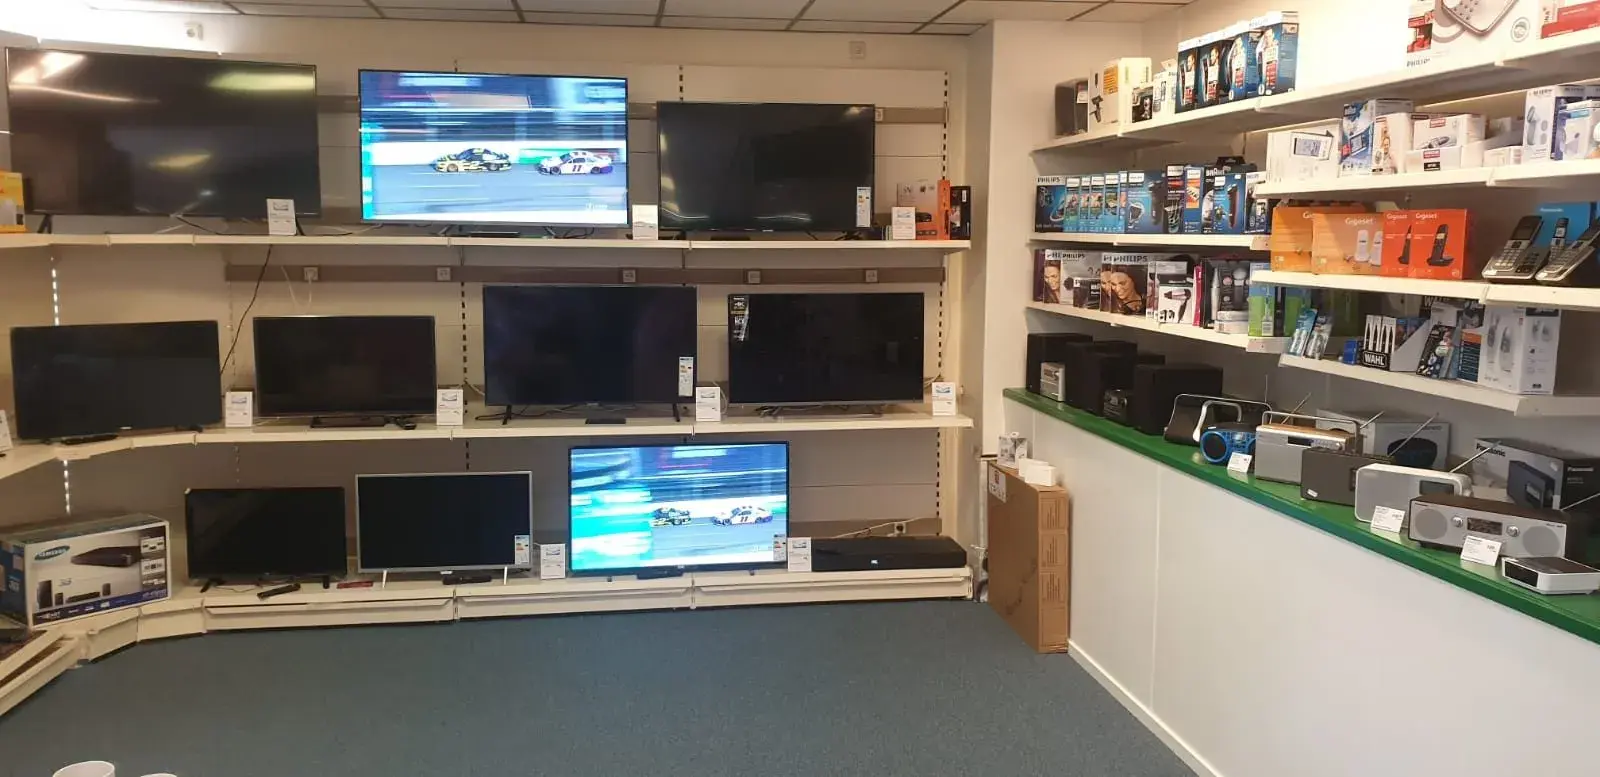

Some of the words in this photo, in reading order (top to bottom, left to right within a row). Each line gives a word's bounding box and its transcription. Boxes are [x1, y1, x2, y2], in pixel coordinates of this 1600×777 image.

[1415, 212, 1438, 220] Gigaset
[1344, 217, 1374, 226] Gigaset
[1364, 353, 1385, 366] WAHL
